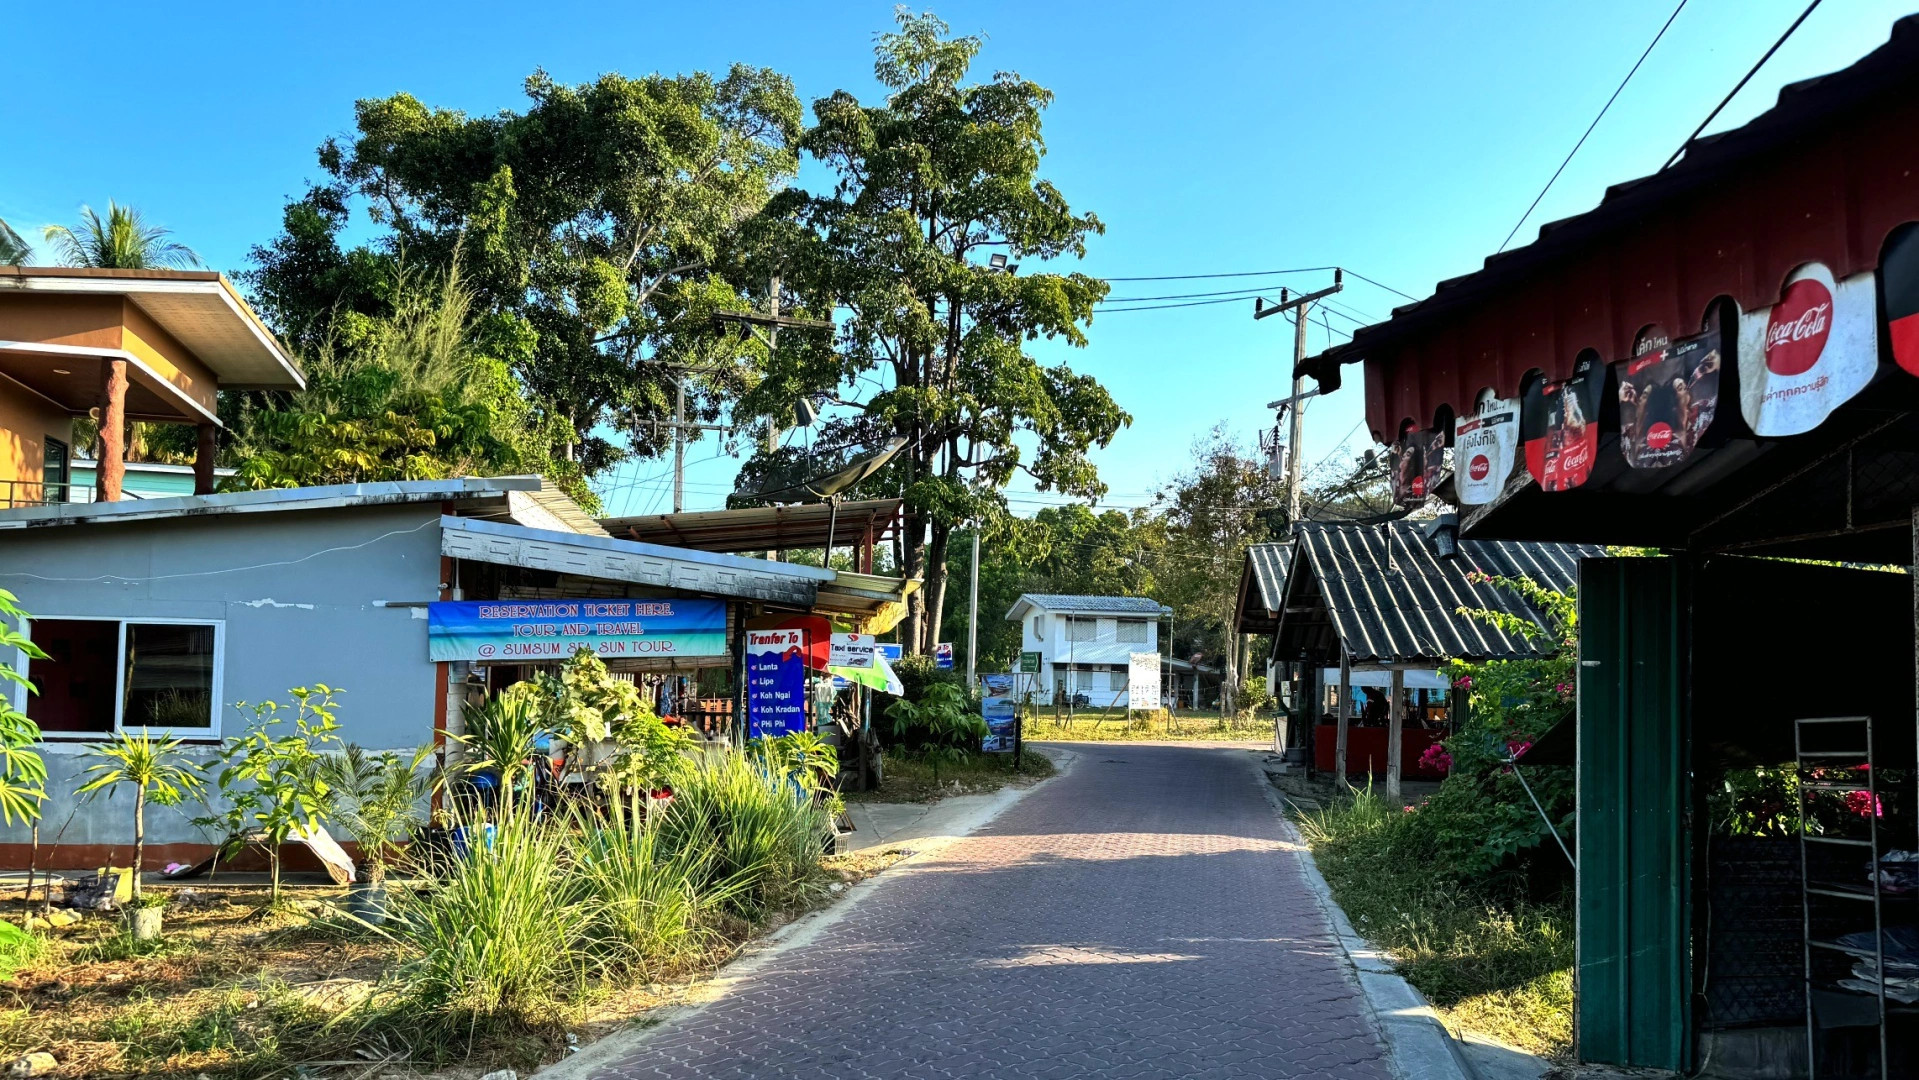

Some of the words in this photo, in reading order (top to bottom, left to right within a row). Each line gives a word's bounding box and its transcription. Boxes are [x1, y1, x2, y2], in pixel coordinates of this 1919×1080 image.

[1766, 302, 1830, 352] Coca-Cola
[479, 603, 579, 619] RESERVATION
[584, 603, 631, 617] TICKET
[635, 602, 675, 617] HERE.
[512, 623, 557, 637] TOUR
[561, 623, 590, 636] AND
[596, 621, 645, 636] TRAVEL
[750, 632, 786, 645] Tranfer
[788, 631, 799, 644] To
[478, 643, 496, 657] @
[503, 642, 561, 655] SUMSUM
[599, 641, 626, 654] SUN
[632, 640, 677, 653] TOUR.
[830, 643, 846, 652] Taxi
[847, 646, 874, 654] service
[759, 663, 778, 671] Lanta
[759, 678, 774, 686] Lipe
[760, 691, 773, 699] Koh
[775, 690, 791, 700] Ngai
[760, 706, 774, 714] Koh
[775, 705, 801, 713] Kradan
[775, 720, 786, 728] Phi
